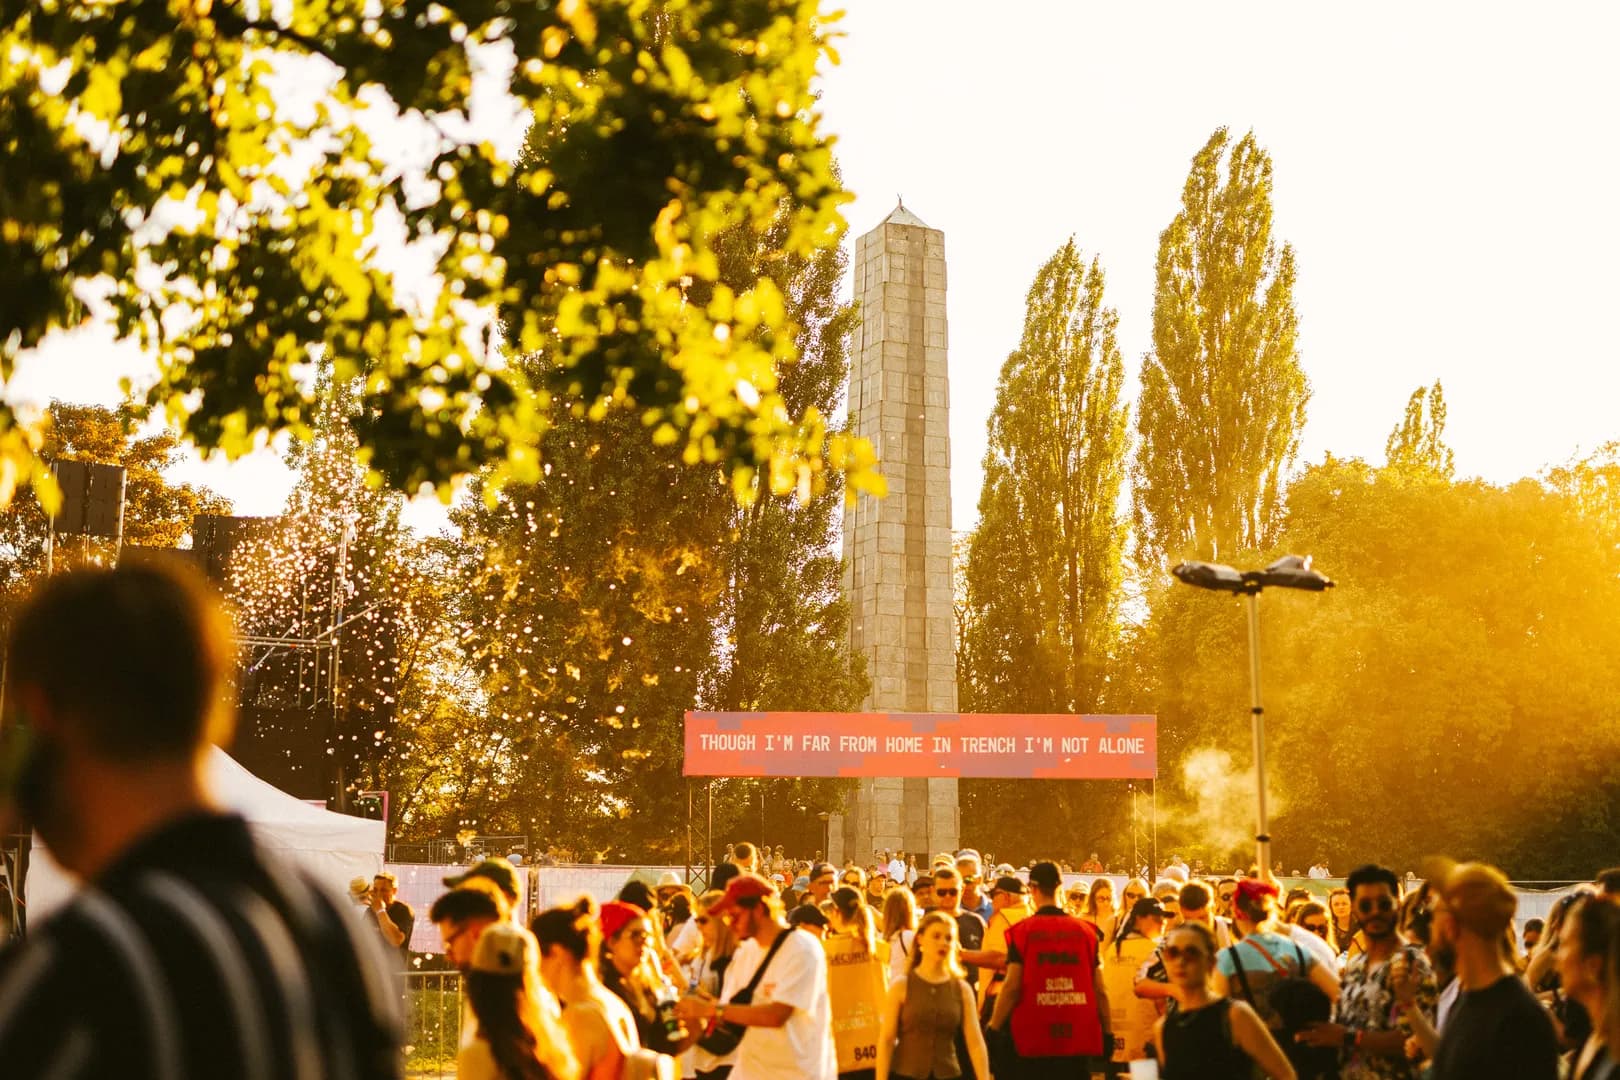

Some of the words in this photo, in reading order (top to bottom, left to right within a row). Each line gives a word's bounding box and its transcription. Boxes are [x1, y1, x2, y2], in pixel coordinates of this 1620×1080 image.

[700, 734, 756, 751] THOUGH
[765, 735, 793, 751] I'M
[802, 735, 830, 752] FAR
[839, 735, 877, 753] FROM
[885, 736, 923, 753] HOME
[932, 737, 951, 753] IN
[960, 737, 1016, 753] TRENCH
[1025, 737, 1053, 753] I'M
[1061, 737, 1089, 753] NOT
[1099, 737, 1145, 754] ALONE
[854, 1045, 877, 1061] 840
